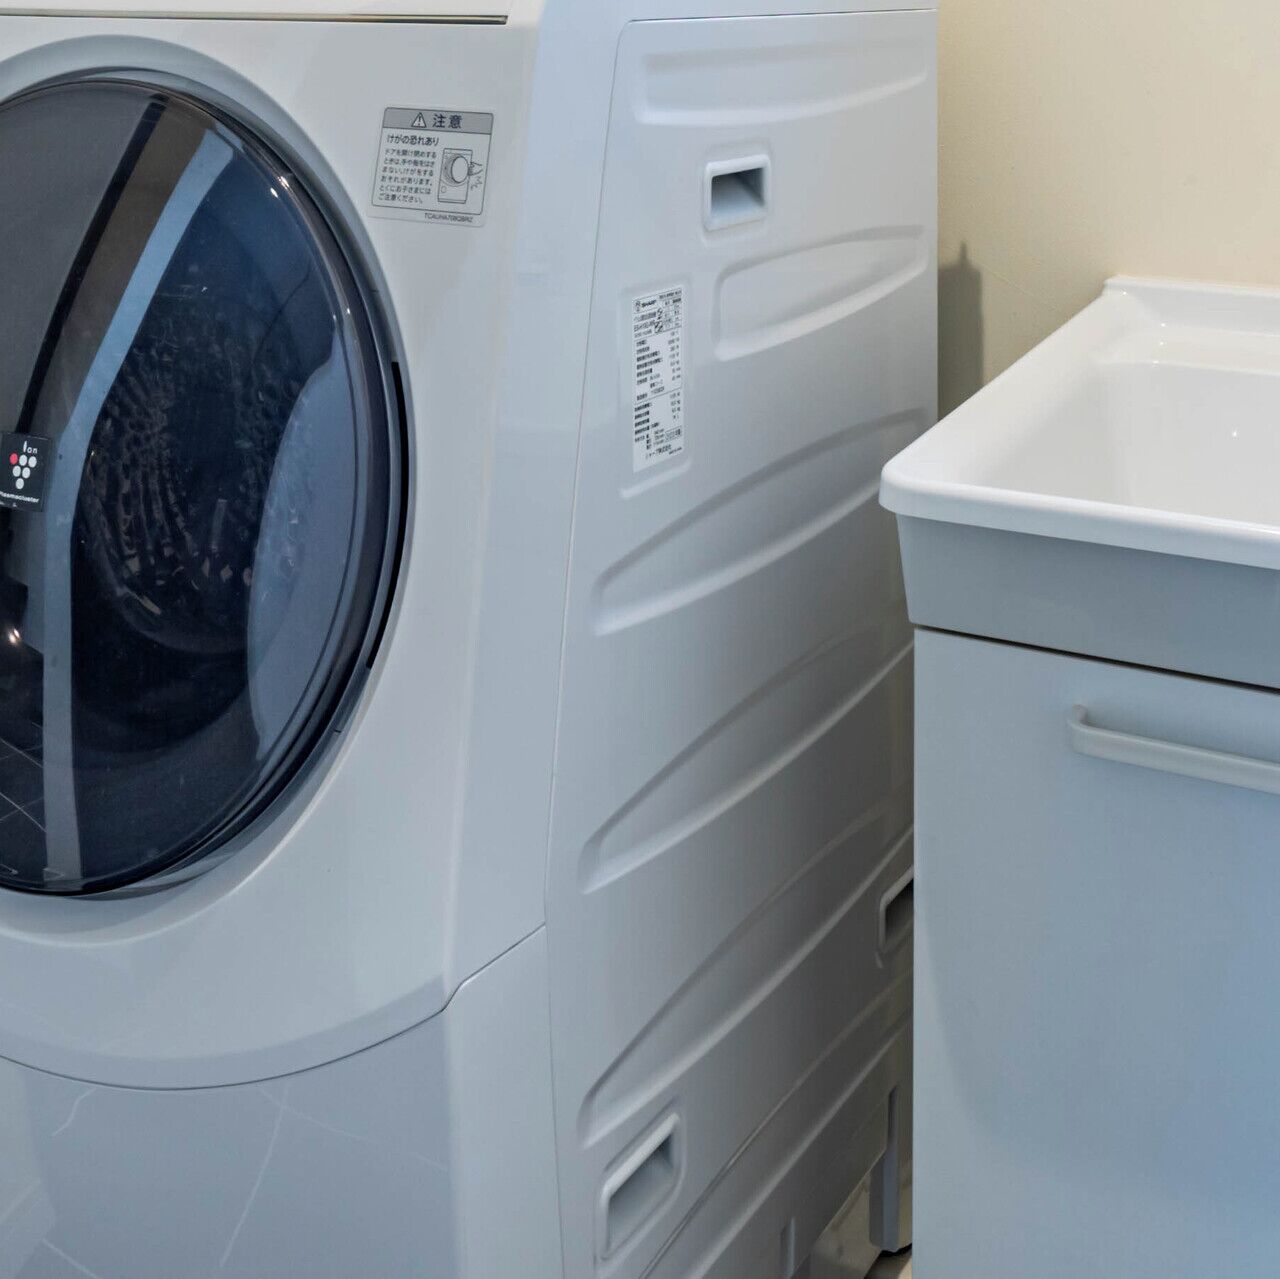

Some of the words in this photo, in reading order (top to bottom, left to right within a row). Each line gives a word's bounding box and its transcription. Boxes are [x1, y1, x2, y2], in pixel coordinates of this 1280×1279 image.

[432, 113, 463, 129] 注意
[386, 133, 440, 146] けがの恐れあり
[23, 440, 38, 454] Ion
